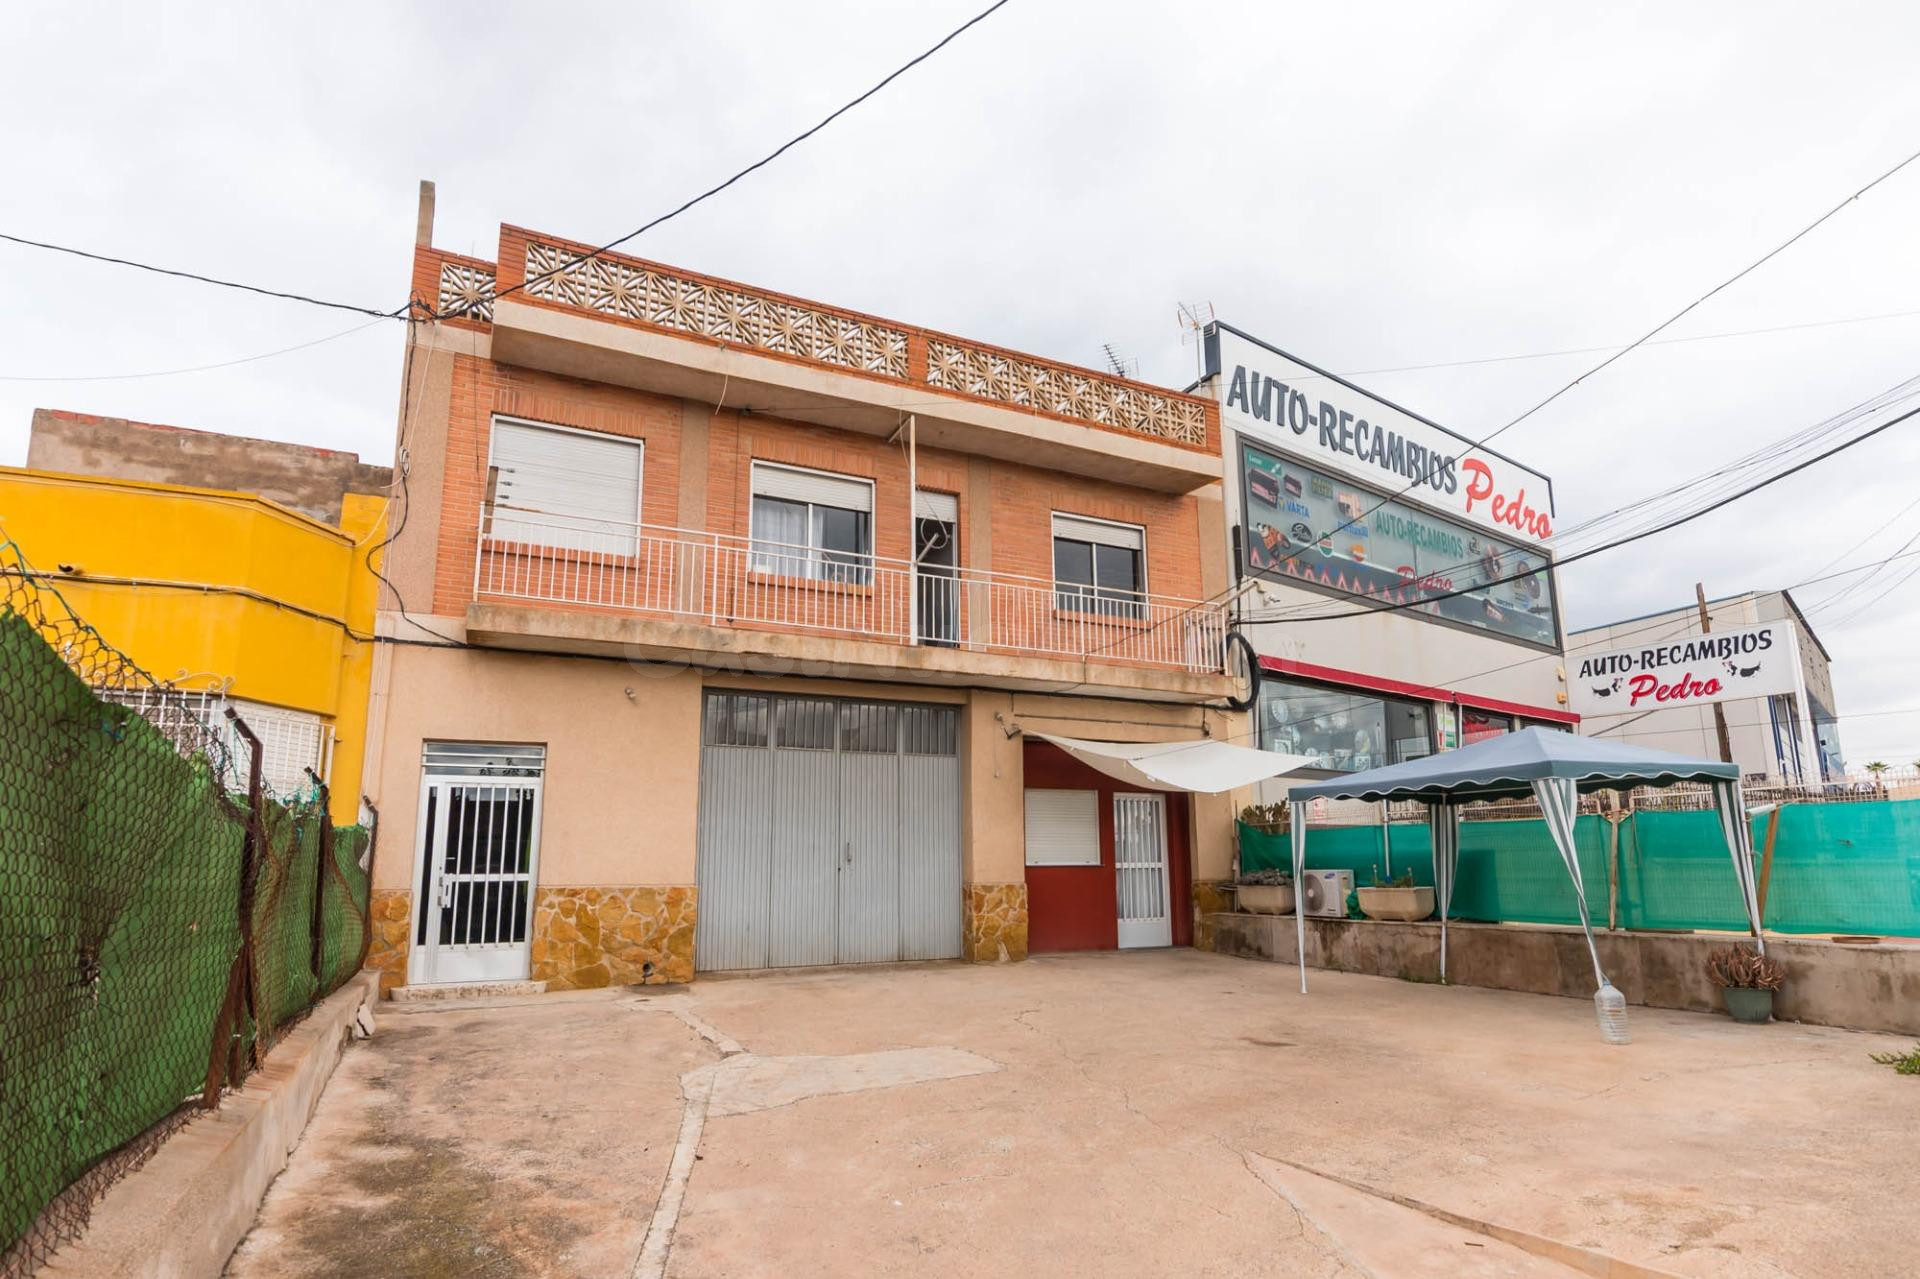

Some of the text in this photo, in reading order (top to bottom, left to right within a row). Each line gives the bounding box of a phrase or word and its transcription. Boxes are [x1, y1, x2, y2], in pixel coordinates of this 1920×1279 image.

[1227, 365, 1553, 539] AUTO-RECAMBIOS Pedro
[1375, 510, 1464, 559] AUTO-RECAMBIOS
[1579, 629, 1772, 678] AUTO-RECAMBIOS
[1628, 672, 1722, 706] Pedro
